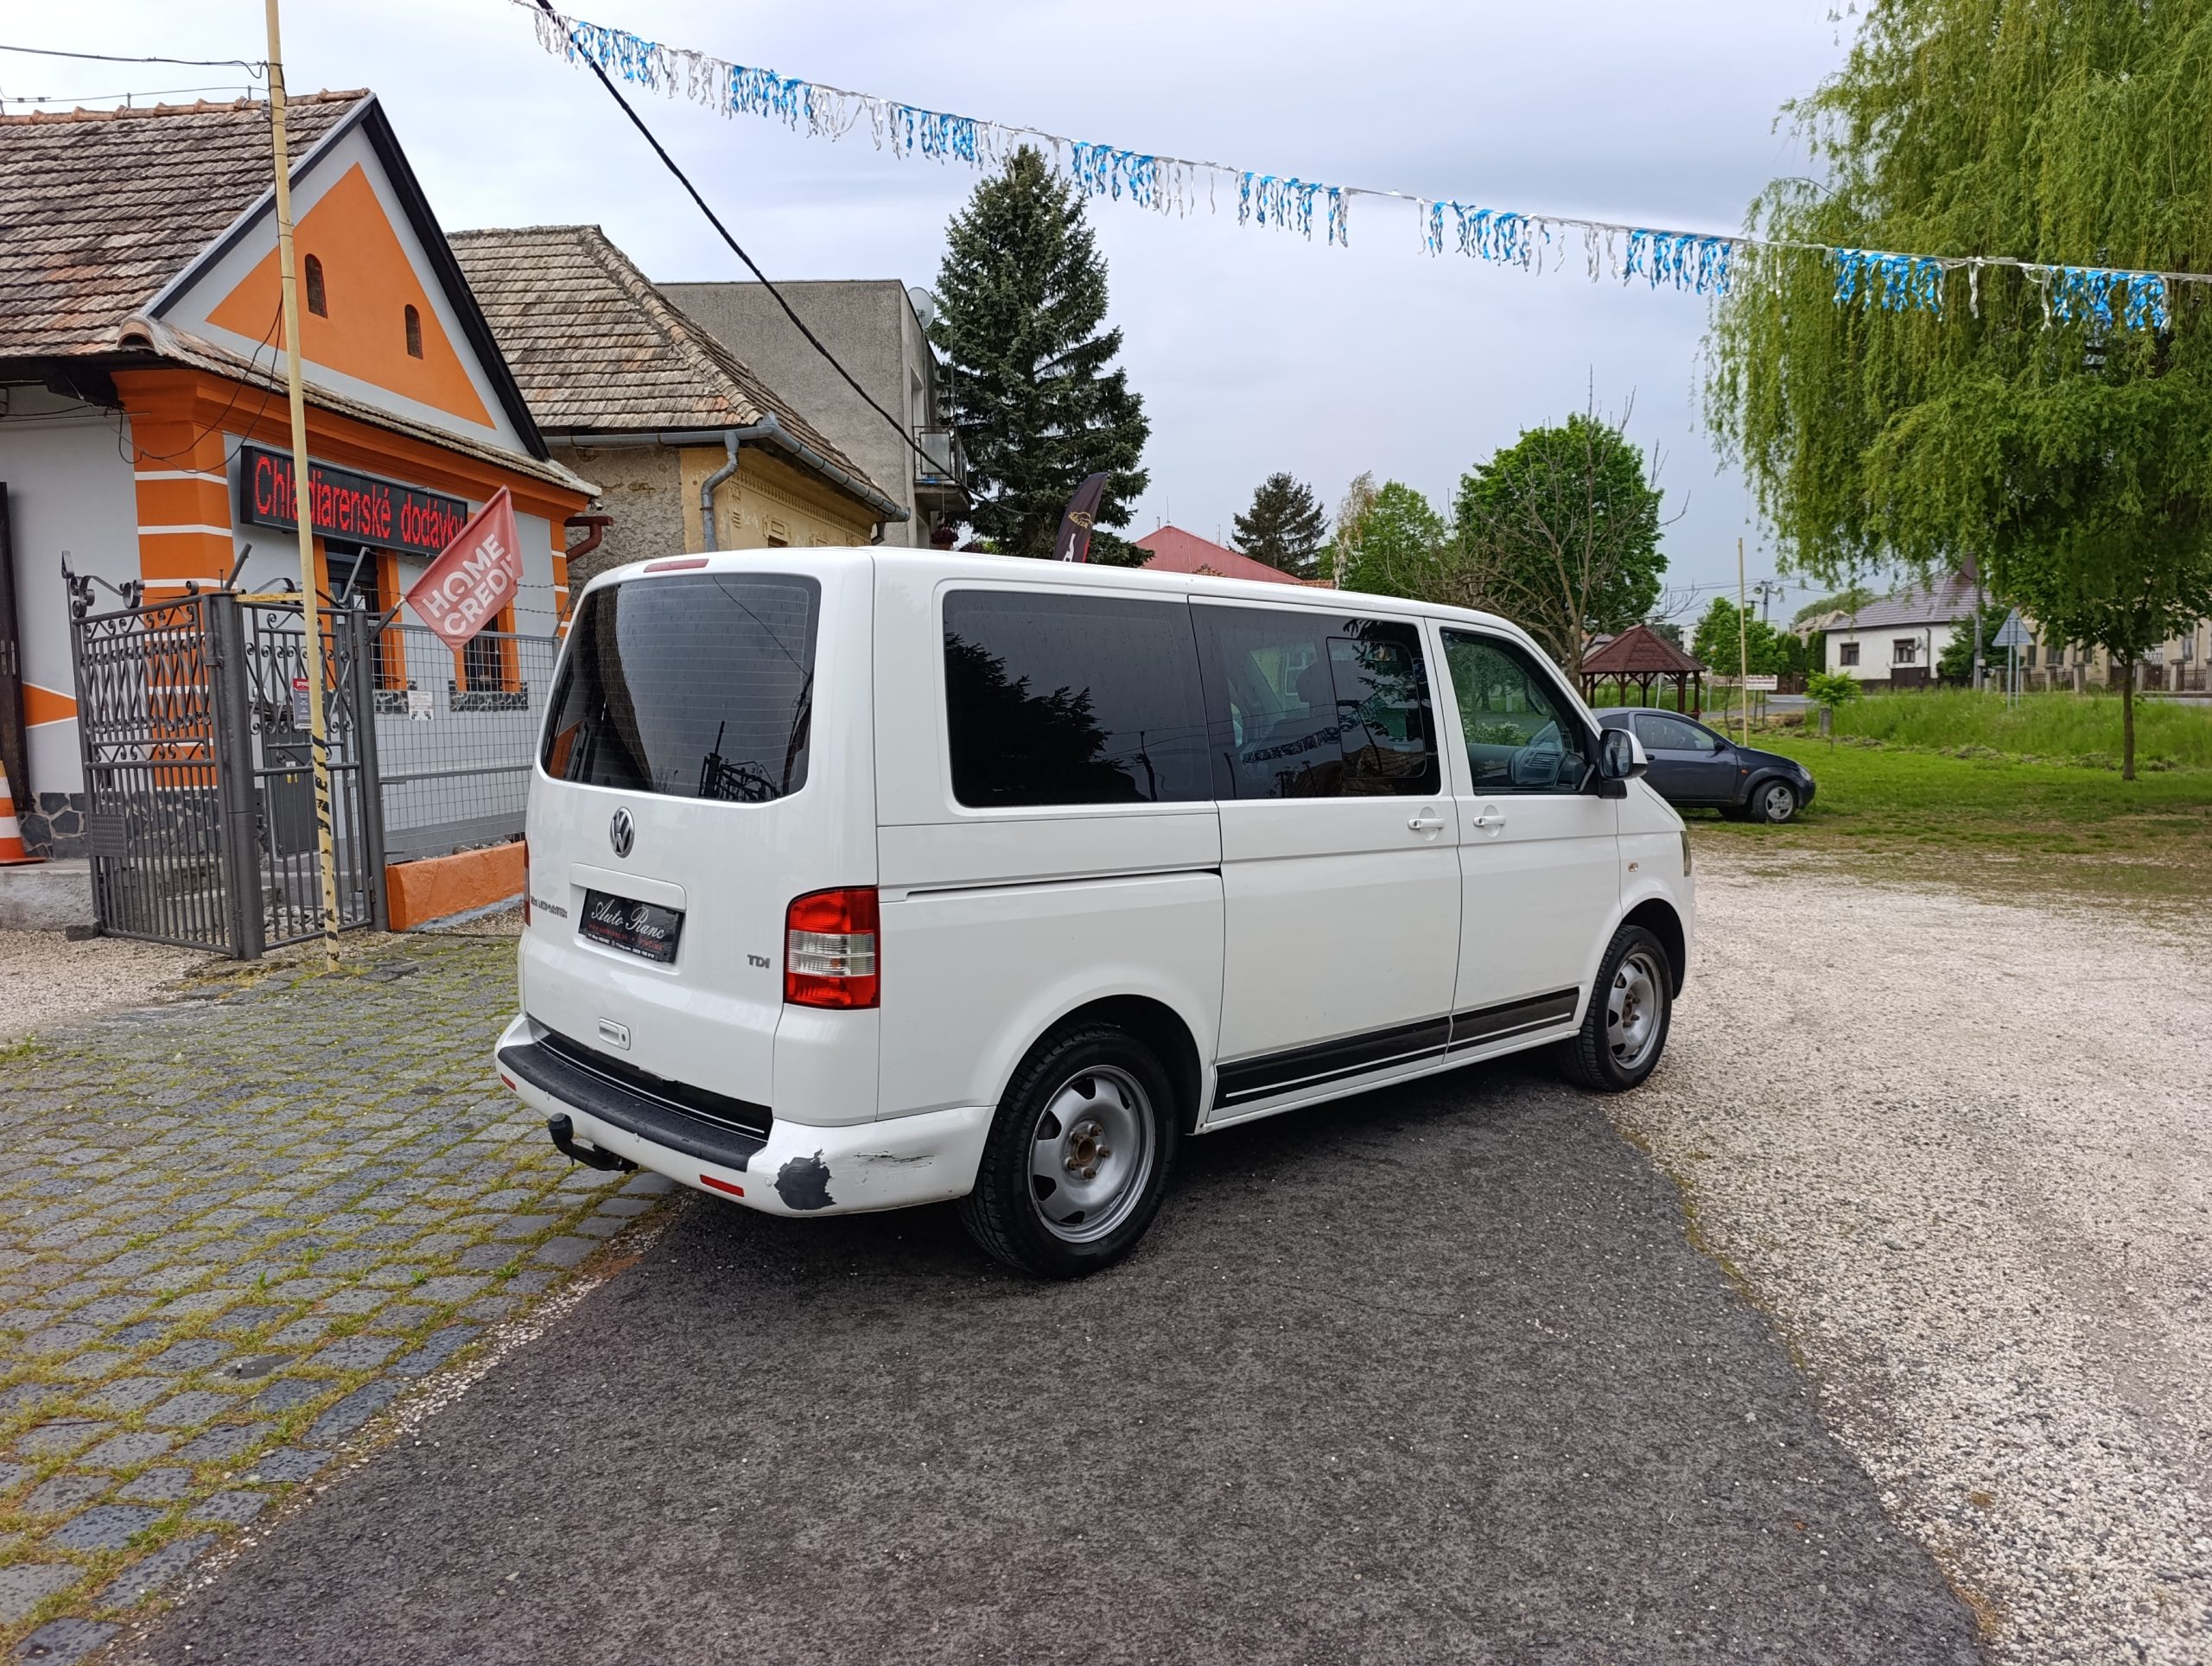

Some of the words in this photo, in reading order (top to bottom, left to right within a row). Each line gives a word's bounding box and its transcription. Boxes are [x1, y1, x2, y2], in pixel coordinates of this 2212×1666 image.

[422, 533, 505, 618] HOME
[444, 553, 512, 635] CREDI
[591, 899, 623, 925] Auto
[747, 954, 771, 969] TDI
